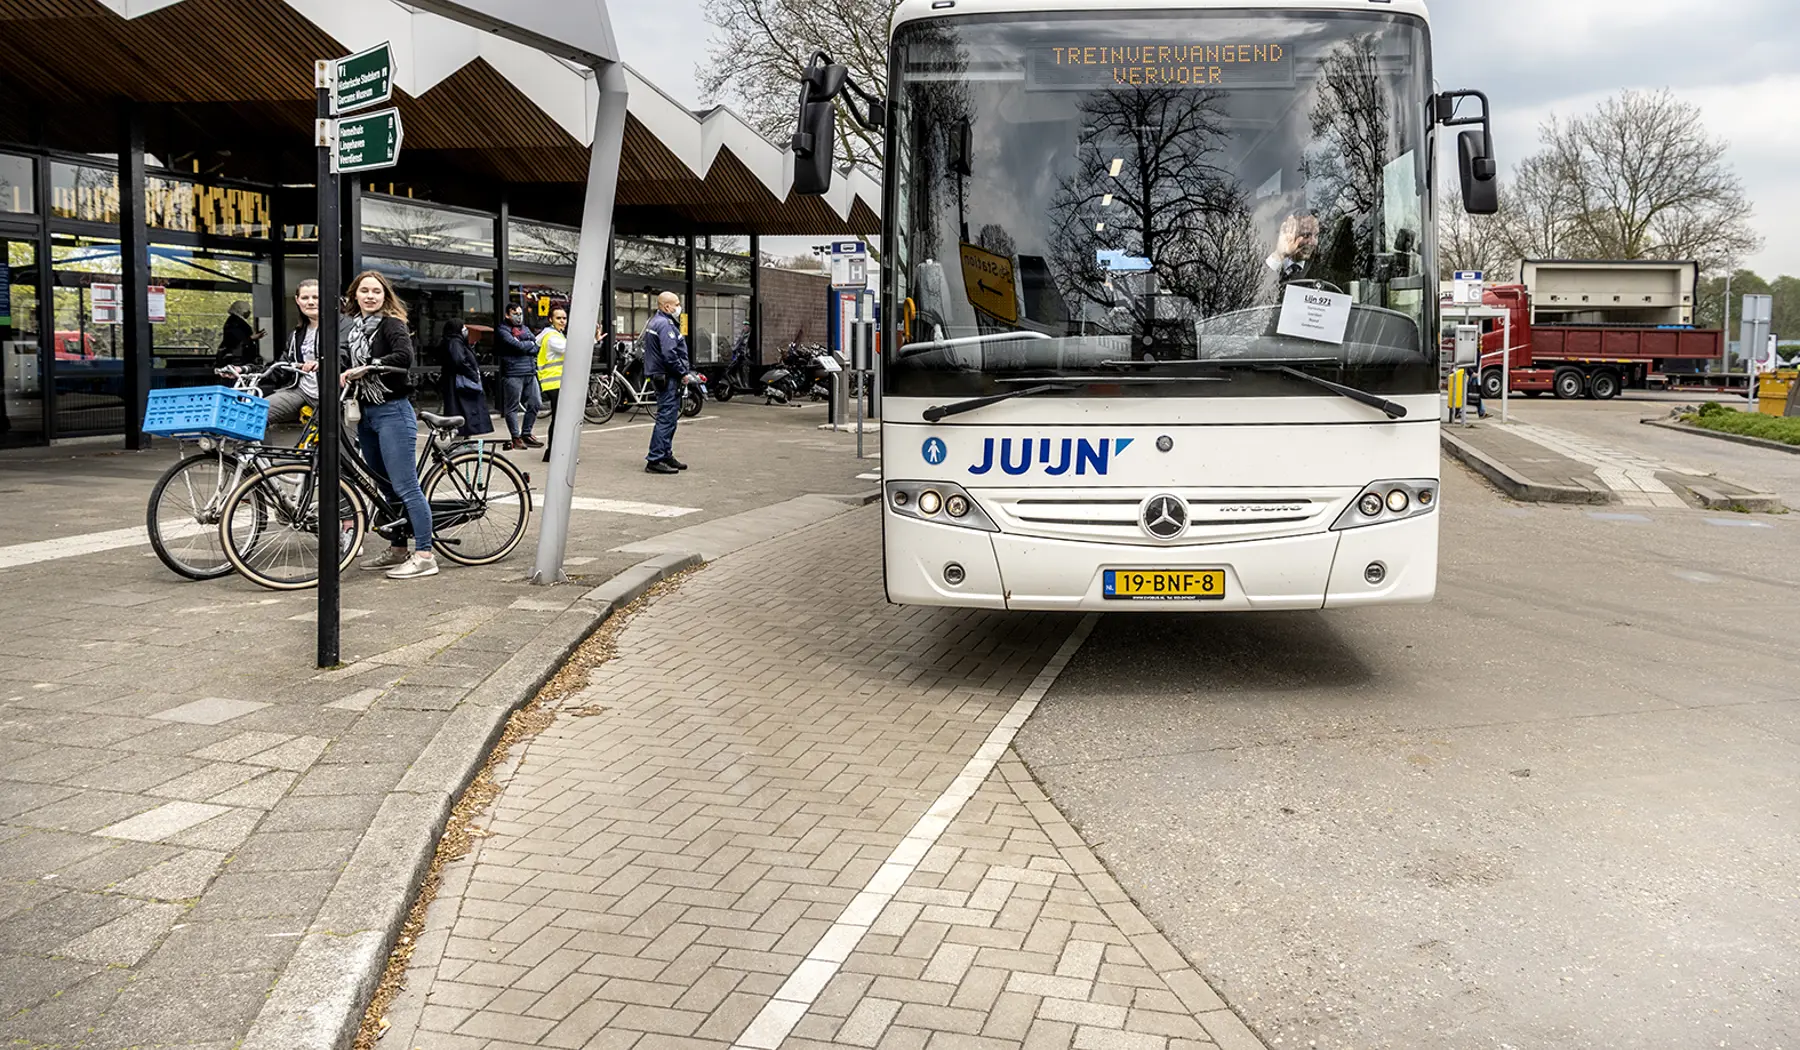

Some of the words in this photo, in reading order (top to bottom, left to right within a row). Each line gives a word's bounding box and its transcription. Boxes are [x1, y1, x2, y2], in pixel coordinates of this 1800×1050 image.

[1052, 44, 1283, 65] TREINVERVANGEND
[1113, 66, 1223, 85] VERVOER
[851, 265, 863, 280] H
[1304, 294, 1318, 304] Lijn
[1318, 297, 1332, 306] 971
[1469, 288, 1481, 300] G
[1123, 574, 1214, 592] 19-BNF-8
